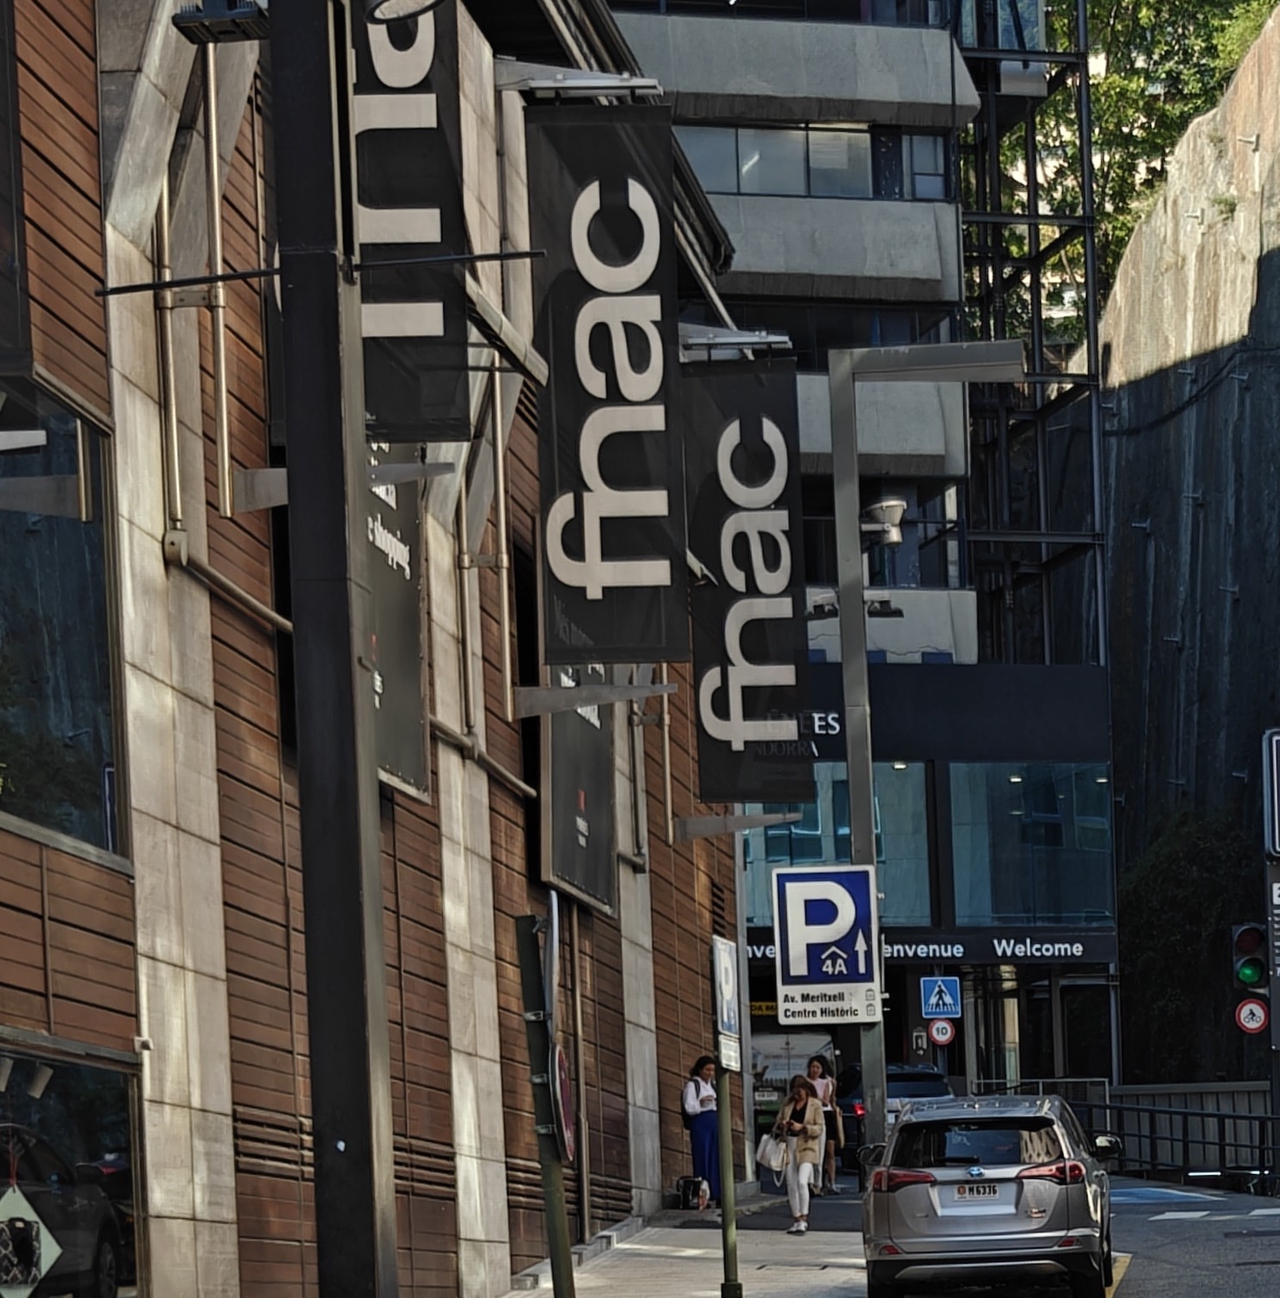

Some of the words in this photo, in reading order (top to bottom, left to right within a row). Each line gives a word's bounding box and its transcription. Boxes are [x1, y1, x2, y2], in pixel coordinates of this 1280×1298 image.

[546, 177, 672, 601] fnac
[699, 414, 800, 752] fnac
[785, 880, 856, 976] P
[993, 938, 1083, 957] Welcome
[821, 959, 847, 976] 4A
[783, 993, 798, 1004] Av.
[801, 991, 845, 1004] Meritxell
[783, 1007, 818, 1019] Centre
[820, 1005, 859, 1018] Històric
[935, 1026, 948, 1036] 10
